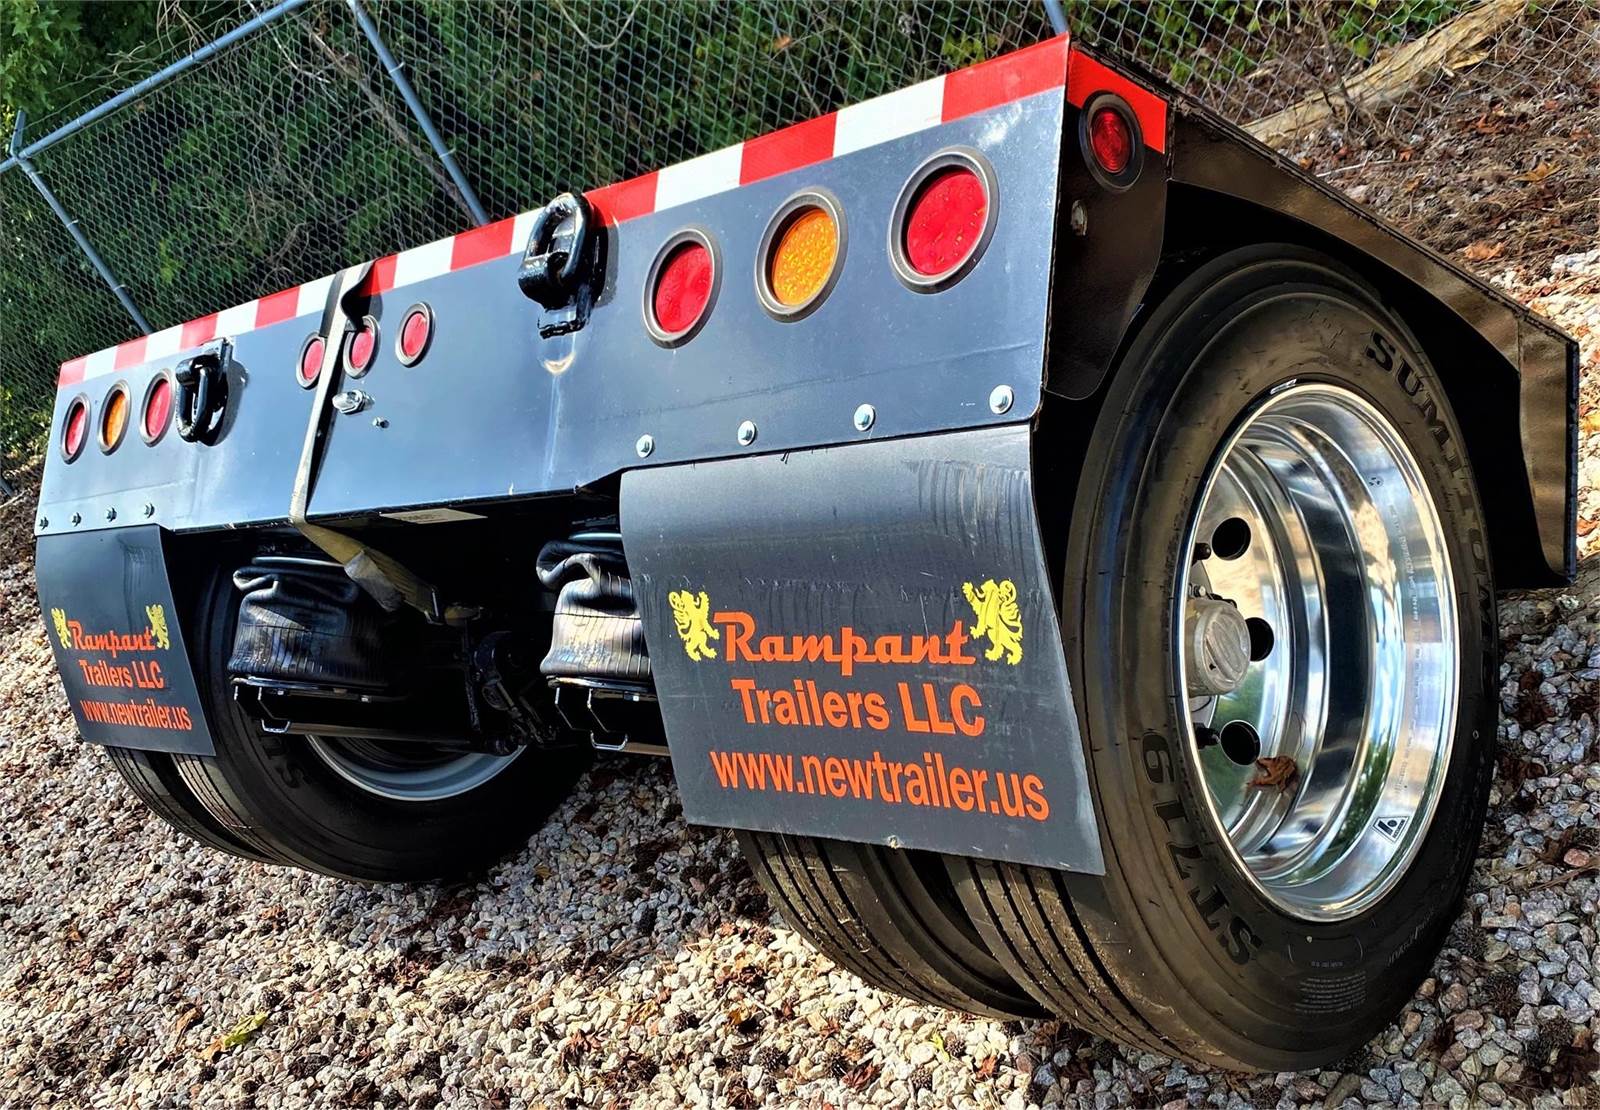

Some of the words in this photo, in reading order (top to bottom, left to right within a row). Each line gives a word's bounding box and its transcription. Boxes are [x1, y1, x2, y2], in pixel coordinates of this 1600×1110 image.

[67, 620, 157, 658] Rampant
[713, 610, 977, 677] Rampant
[78, 659, 134, 688] Trailers
[132, 660, 165, 689] LLC
[80, 699, 192, 731] www.newtrailer.us
[730, 678, 890, 730] Trailers
[897, 682, 986, 737] LLC
[709, 751, 1050, 822] www.newtrailer.us
